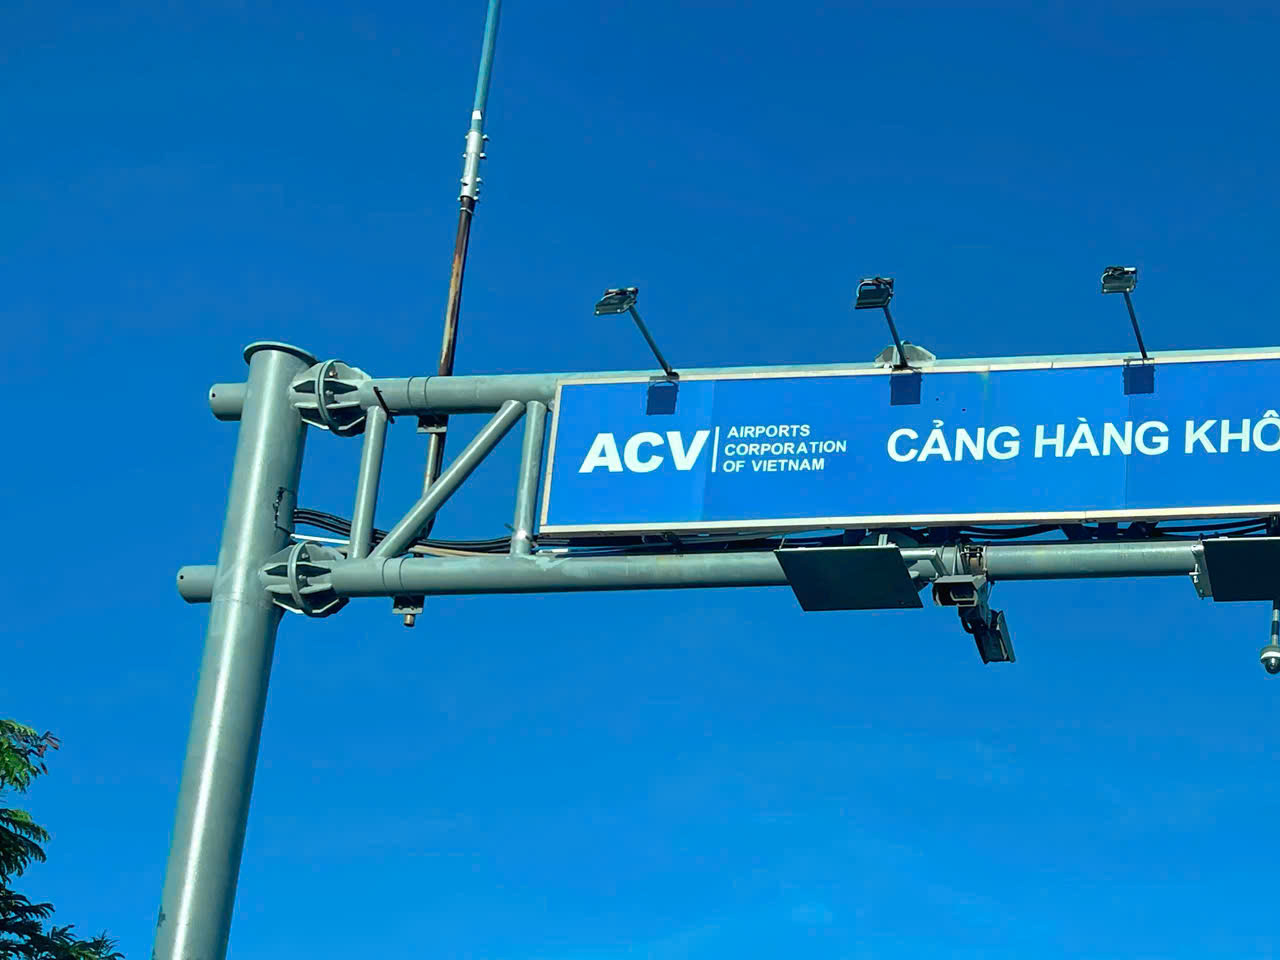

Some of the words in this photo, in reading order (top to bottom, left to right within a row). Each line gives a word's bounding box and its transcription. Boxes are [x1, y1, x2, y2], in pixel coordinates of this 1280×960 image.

[727, 424, 811, 438] AIRPORTS
[724, 440, 847, 457] CORPORATION
[887, 418, 1020, 463] CẢNG
[1034, 417, 1169, 458] HÀNG
[579, 429, 711, 473] ACV
[722, 460, 746, 473] OF
[751, 458, 825, 473] VIETNAM
